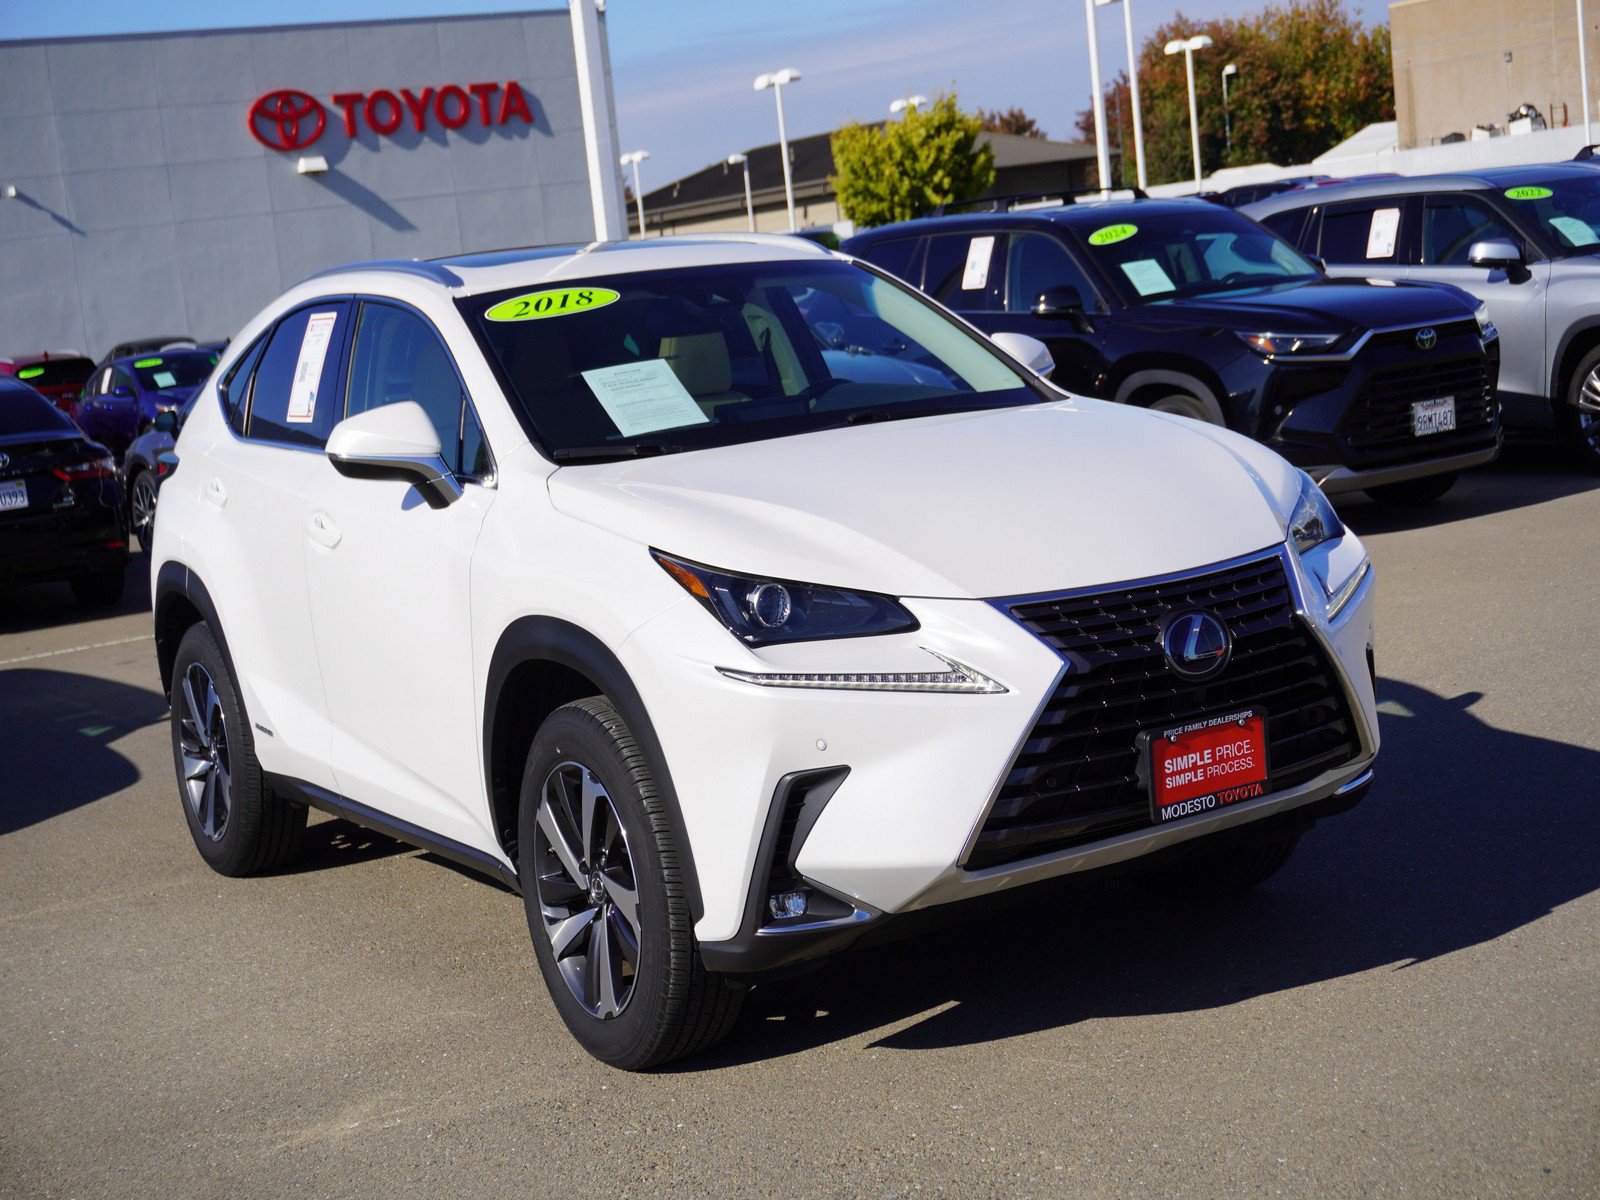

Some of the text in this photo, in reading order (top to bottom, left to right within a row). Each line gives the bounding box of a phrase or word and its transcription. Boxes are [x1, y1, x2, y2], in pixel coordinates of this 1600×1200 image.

[331, 81, 533, 138] TOYOTA
[1100, 226, 1127, 242] 2024
[513, 290, 594, 318] 2018
[1163, 710, 1253, 738] PRICE FAMILY DEALERSHIPS
[1164, 739, 1254, 774] SIMPLE PRICE.
[1165, 757, 1256, 789] SIMPLE PROCESS.
[1161, 783, 1264, 821] MODESTO TOYOTA
